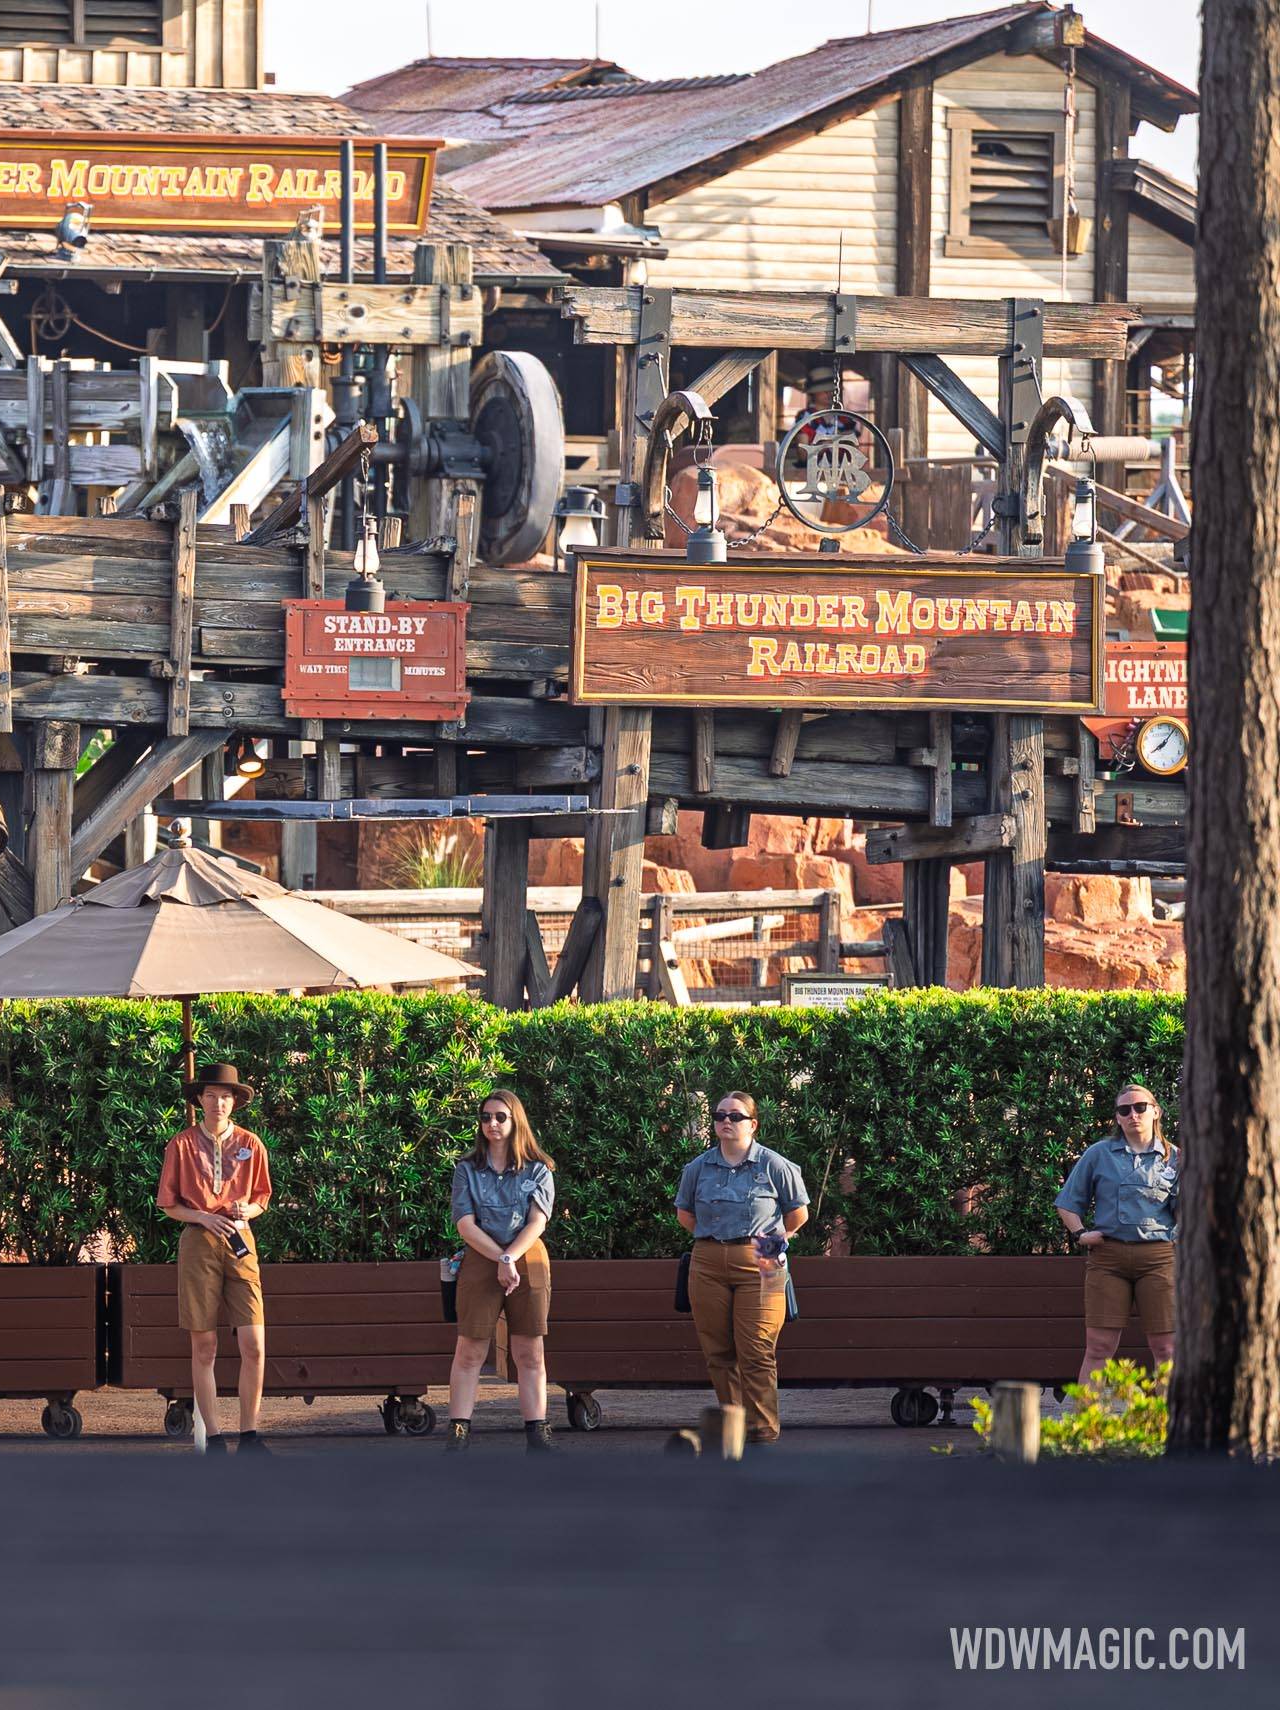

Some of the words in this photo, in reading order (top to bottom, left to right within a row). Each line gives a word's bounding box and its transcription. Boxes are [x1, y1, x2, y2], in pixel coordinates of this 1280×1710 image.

[47, 160, 243, 197] MOUNTAIN
[596, 584, 665, 628] BIG
[676, 586, 868, 629] THUNDER
[875, 590, 1075, 634] MOUNTAIN
[324, 616, 427, 635] STAND-BY
[334, 638, 415, 652] ENTRANCE
[747, 637, 926, 676] RAILROAD
[299, 665, 323, 674] WAIT
[324, 665, 348, 674] TIME
[404, 666, 446, 676] MINUTES
[1104, 659, 1187, 683] IGHTNI
[1127, 686, 1187, 709] LANE
[794, 987, 803, 995] BIG
[804, 987, 827, 995] THUNDER
[827, 987, 855, 995] MOUNTAIN
